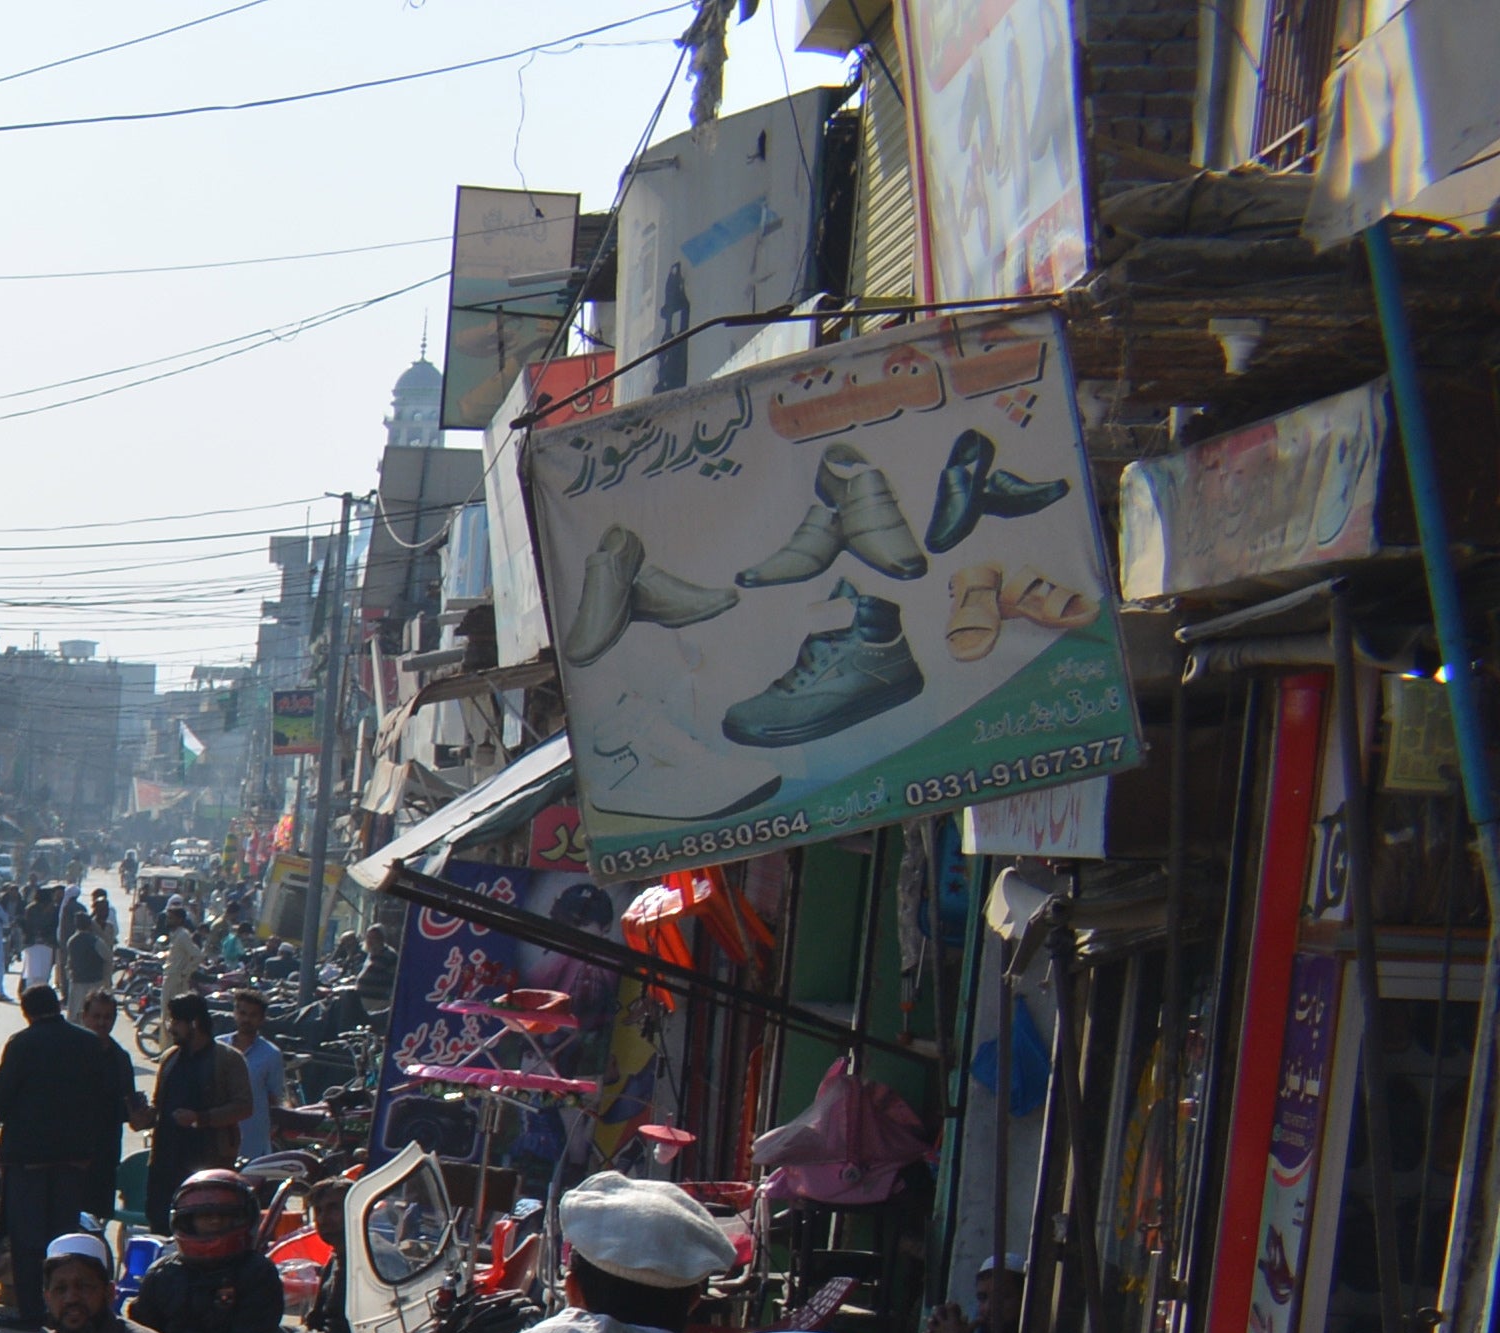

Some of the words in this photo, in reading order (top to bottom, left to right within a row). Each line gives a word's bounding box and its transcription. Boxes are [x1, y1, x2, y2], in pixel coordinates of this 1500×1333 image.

[562, 415, 656, 498] شوز
[643, 386, 754, 481] لیدر
[1062, 686, 1121, 727] فاروق
[906, 737, 1125, 806] 0331-9167377
[601, 811, 809, 876] 0334-8830564
